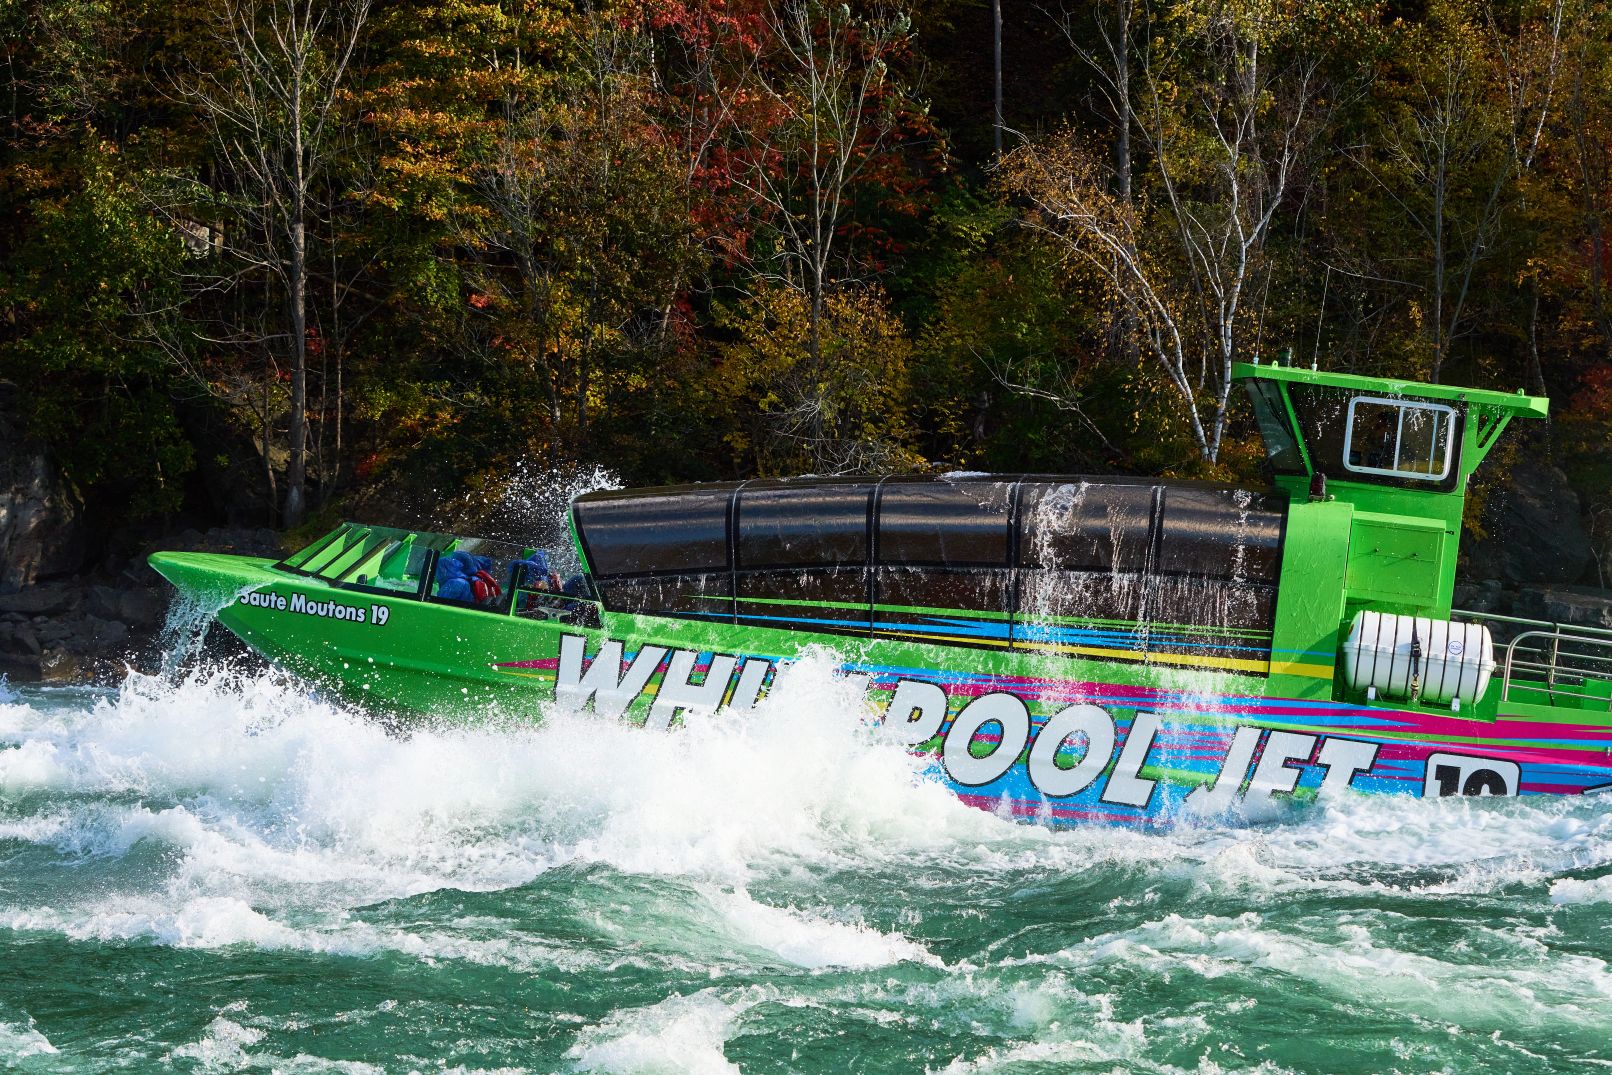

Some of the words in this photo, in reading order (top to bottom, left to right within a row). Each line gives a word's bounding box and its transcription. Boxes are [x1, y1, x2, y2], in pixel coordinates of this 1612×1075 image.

[239, 589, 287, 611] Saute
[289, 592, 367, 624] Moutons
[370, 602, 391, 627] 19
[553, 631, 1163, 809] WHIPOOL
[1183, 724, 1383, 815] JET
